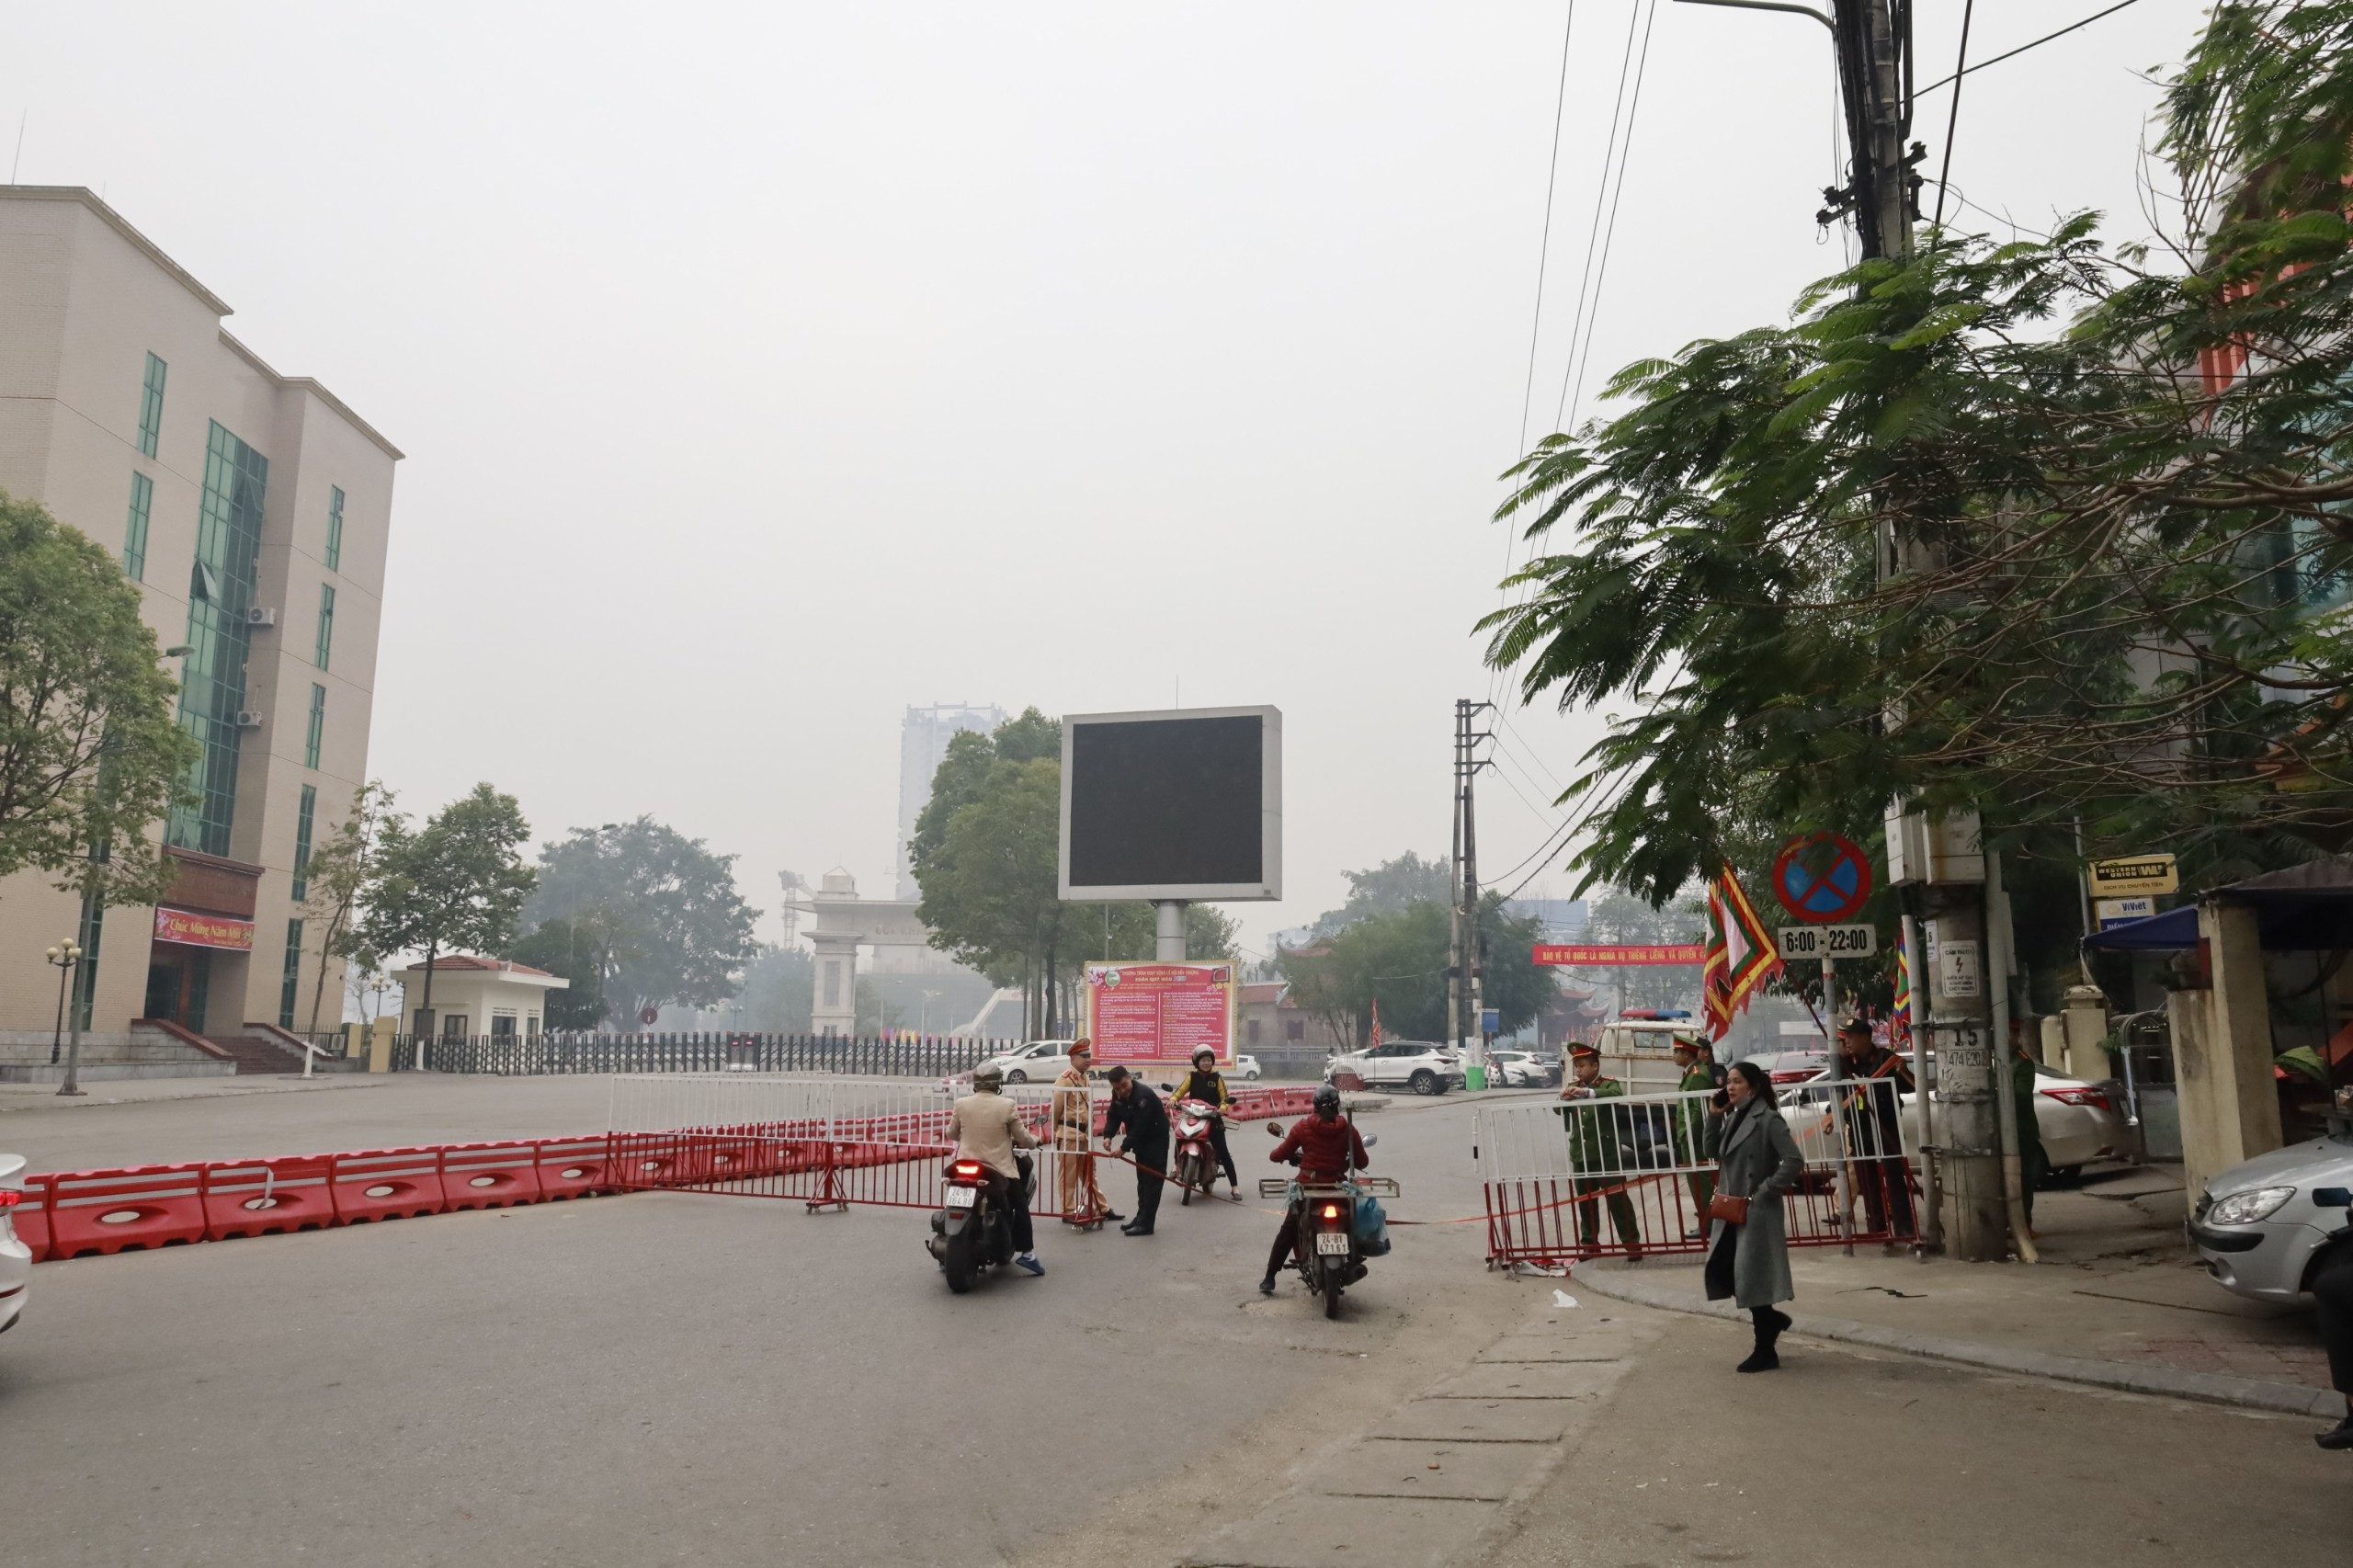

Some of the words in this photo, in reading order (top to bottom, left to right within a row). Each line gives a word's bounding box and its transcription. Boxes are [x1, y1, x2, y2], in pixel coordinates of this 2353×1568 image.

[1786, 930, 1815, 952] 6:00
[1829, 929, 1868, 950] 22:00
[1322, 1234, 1343, 1244] 24-B1
